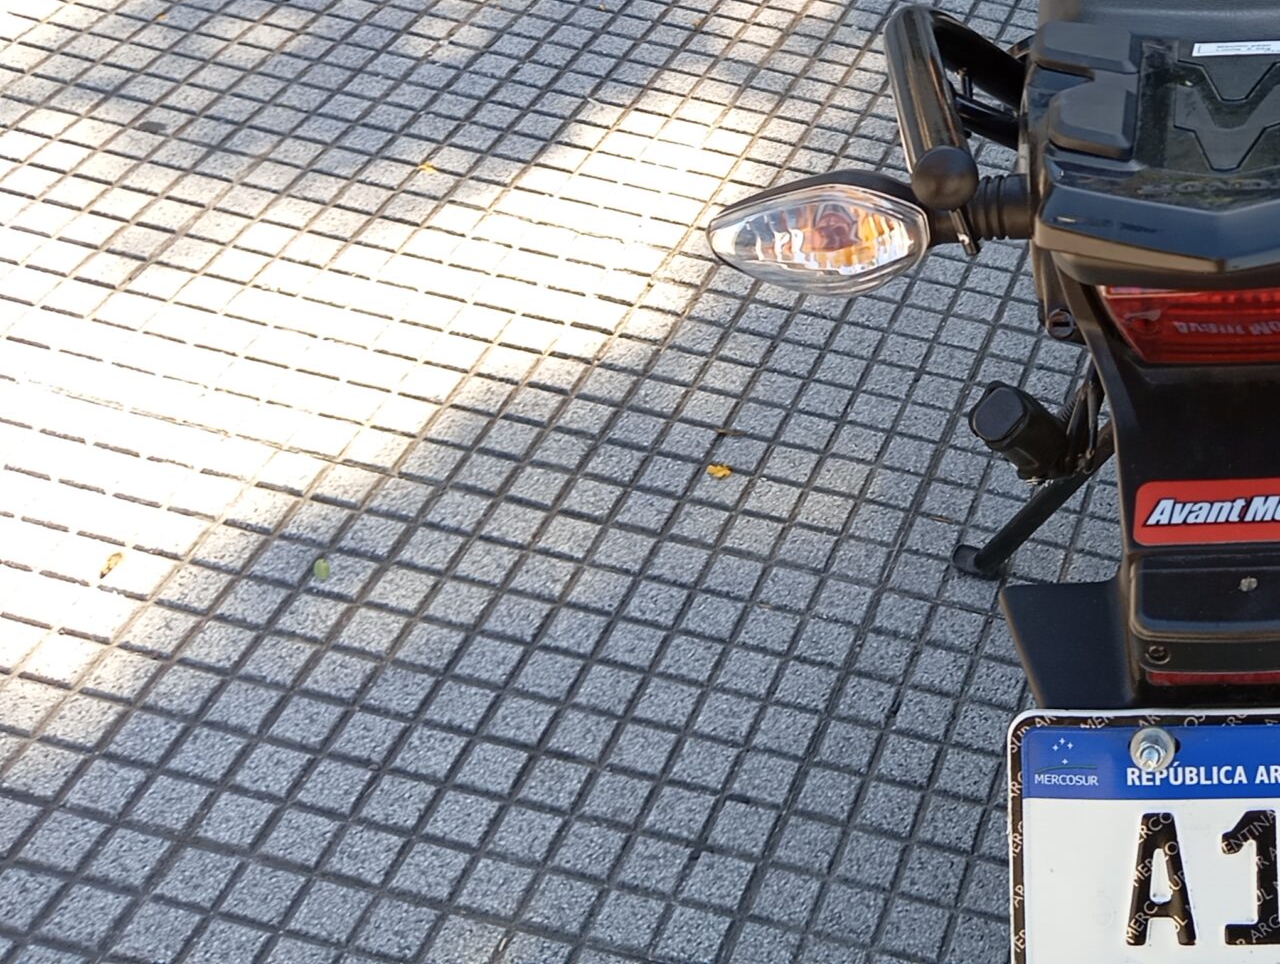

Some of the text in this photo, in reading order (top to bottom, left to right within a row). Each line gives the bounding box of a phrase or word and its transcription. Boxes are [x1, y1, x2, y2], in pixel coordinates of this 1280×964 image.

[1145, 497, 1246, 525] Avant
[1034, 774, 1099, 786] MERCOSUR
[1126, 761, 1248, 785] REPÚBLICA
